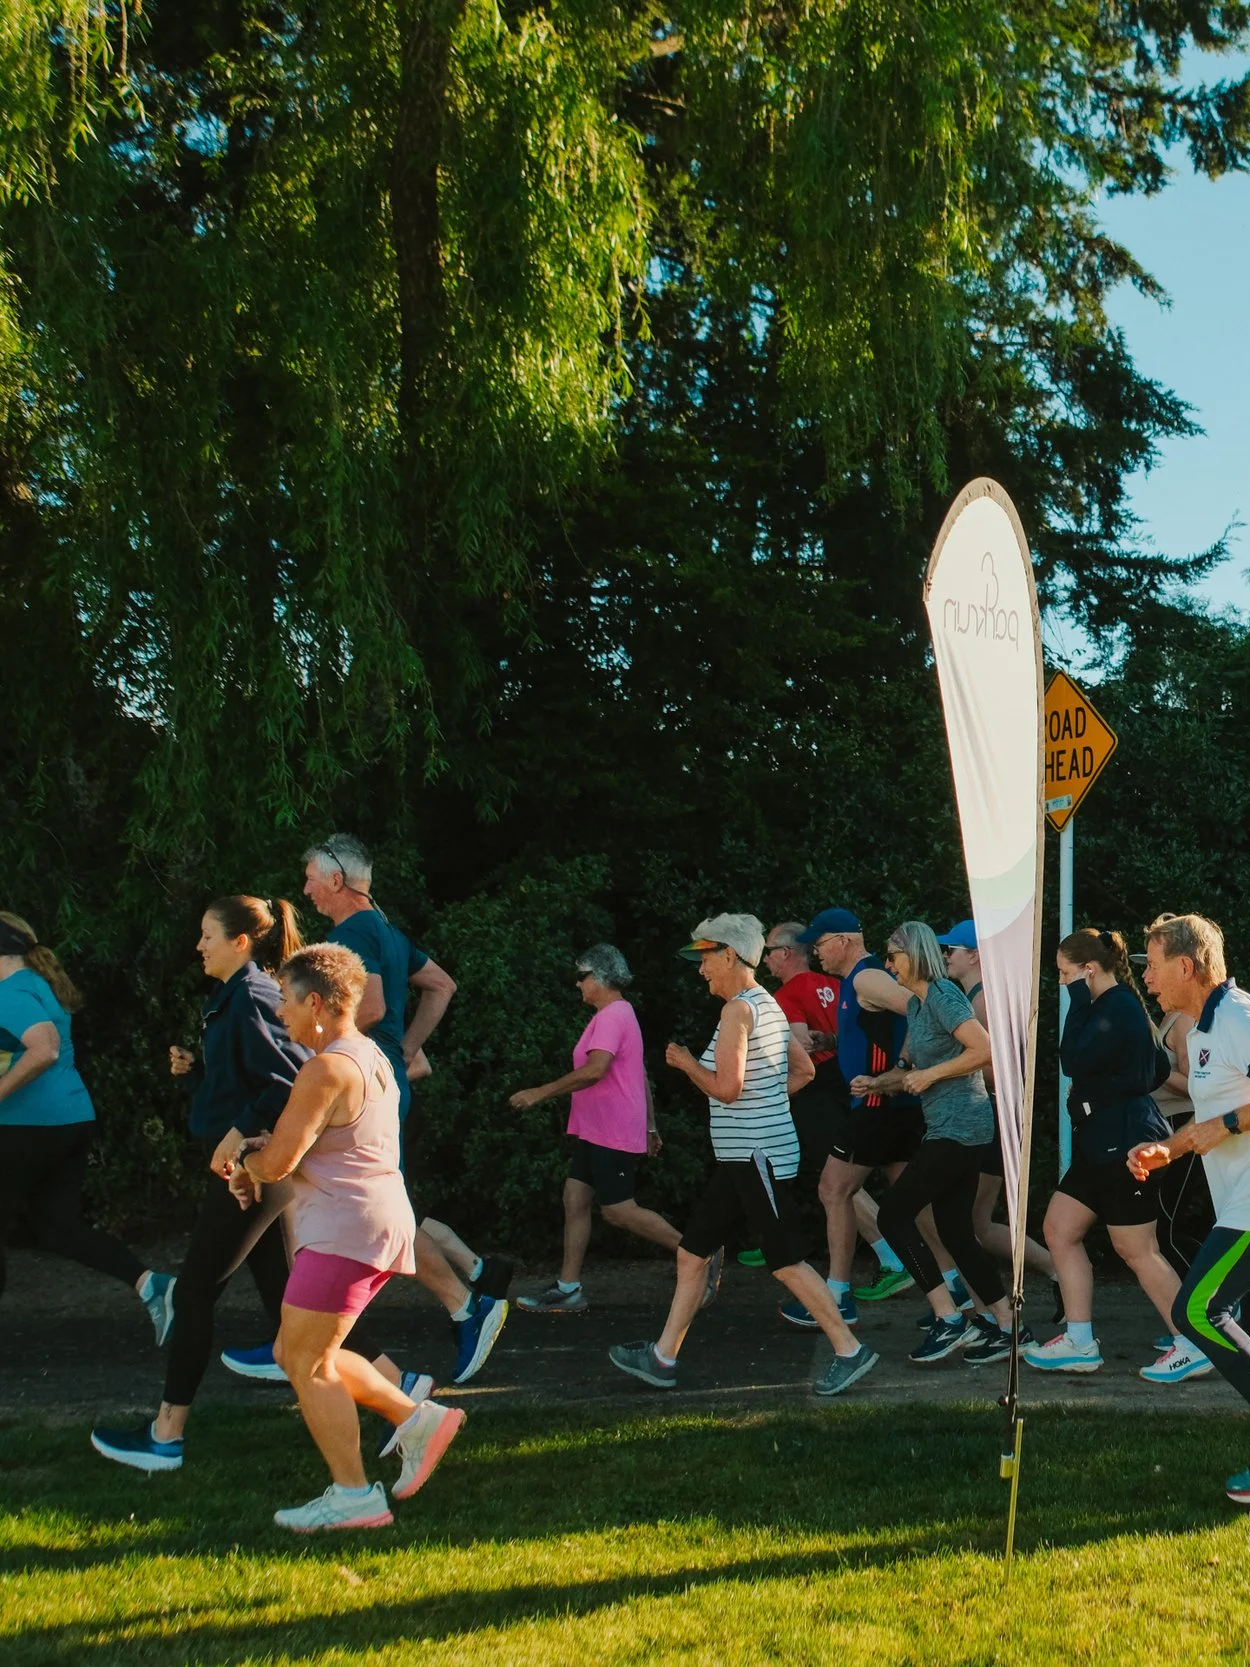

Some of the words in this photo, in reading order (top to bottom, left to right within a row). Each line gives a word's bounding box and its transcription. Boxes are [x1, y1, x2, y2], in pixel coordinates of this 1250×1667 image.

[1045, 706, 1086, 743] OAD
[1045, 745, 1094, 784] HEAD
[1169, 1356, 1191, 1371] HOKA
